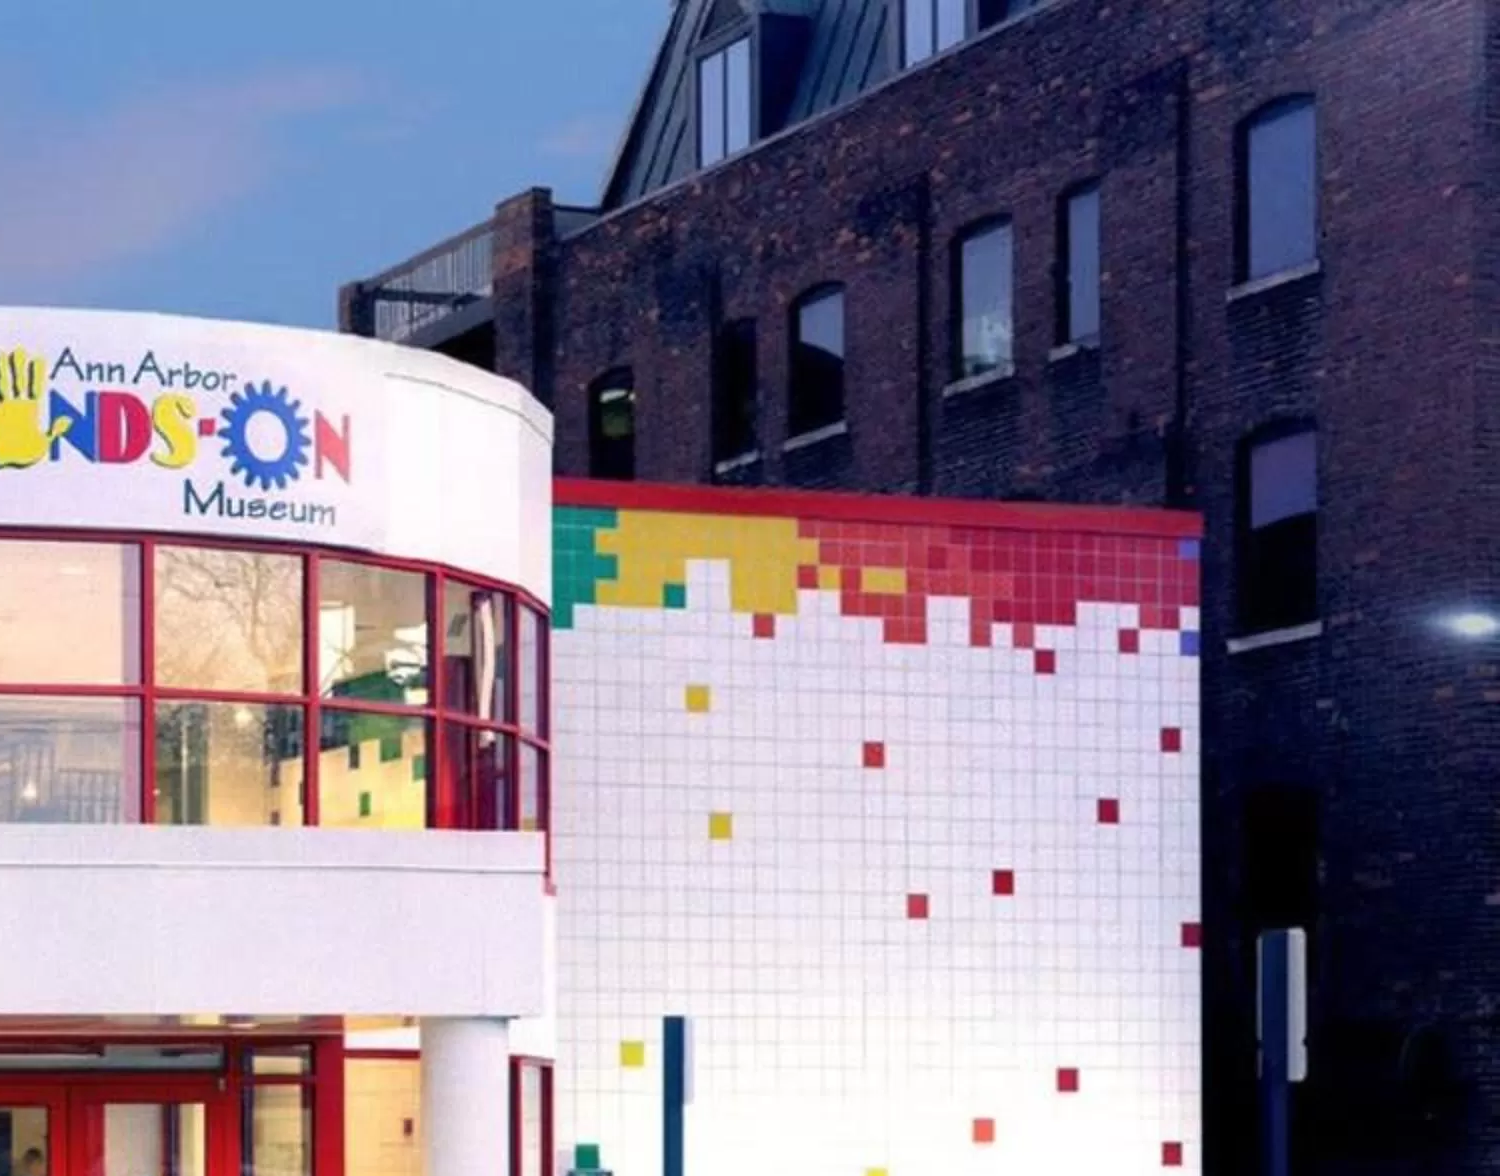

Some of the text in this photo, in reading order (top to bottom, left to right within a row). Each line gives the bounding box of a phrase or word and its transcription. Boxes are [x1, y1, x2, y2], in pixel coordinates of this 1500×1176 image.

[49, 346, 238, 392] Ann Arbor
[183, 477, 336, 527] Museum
